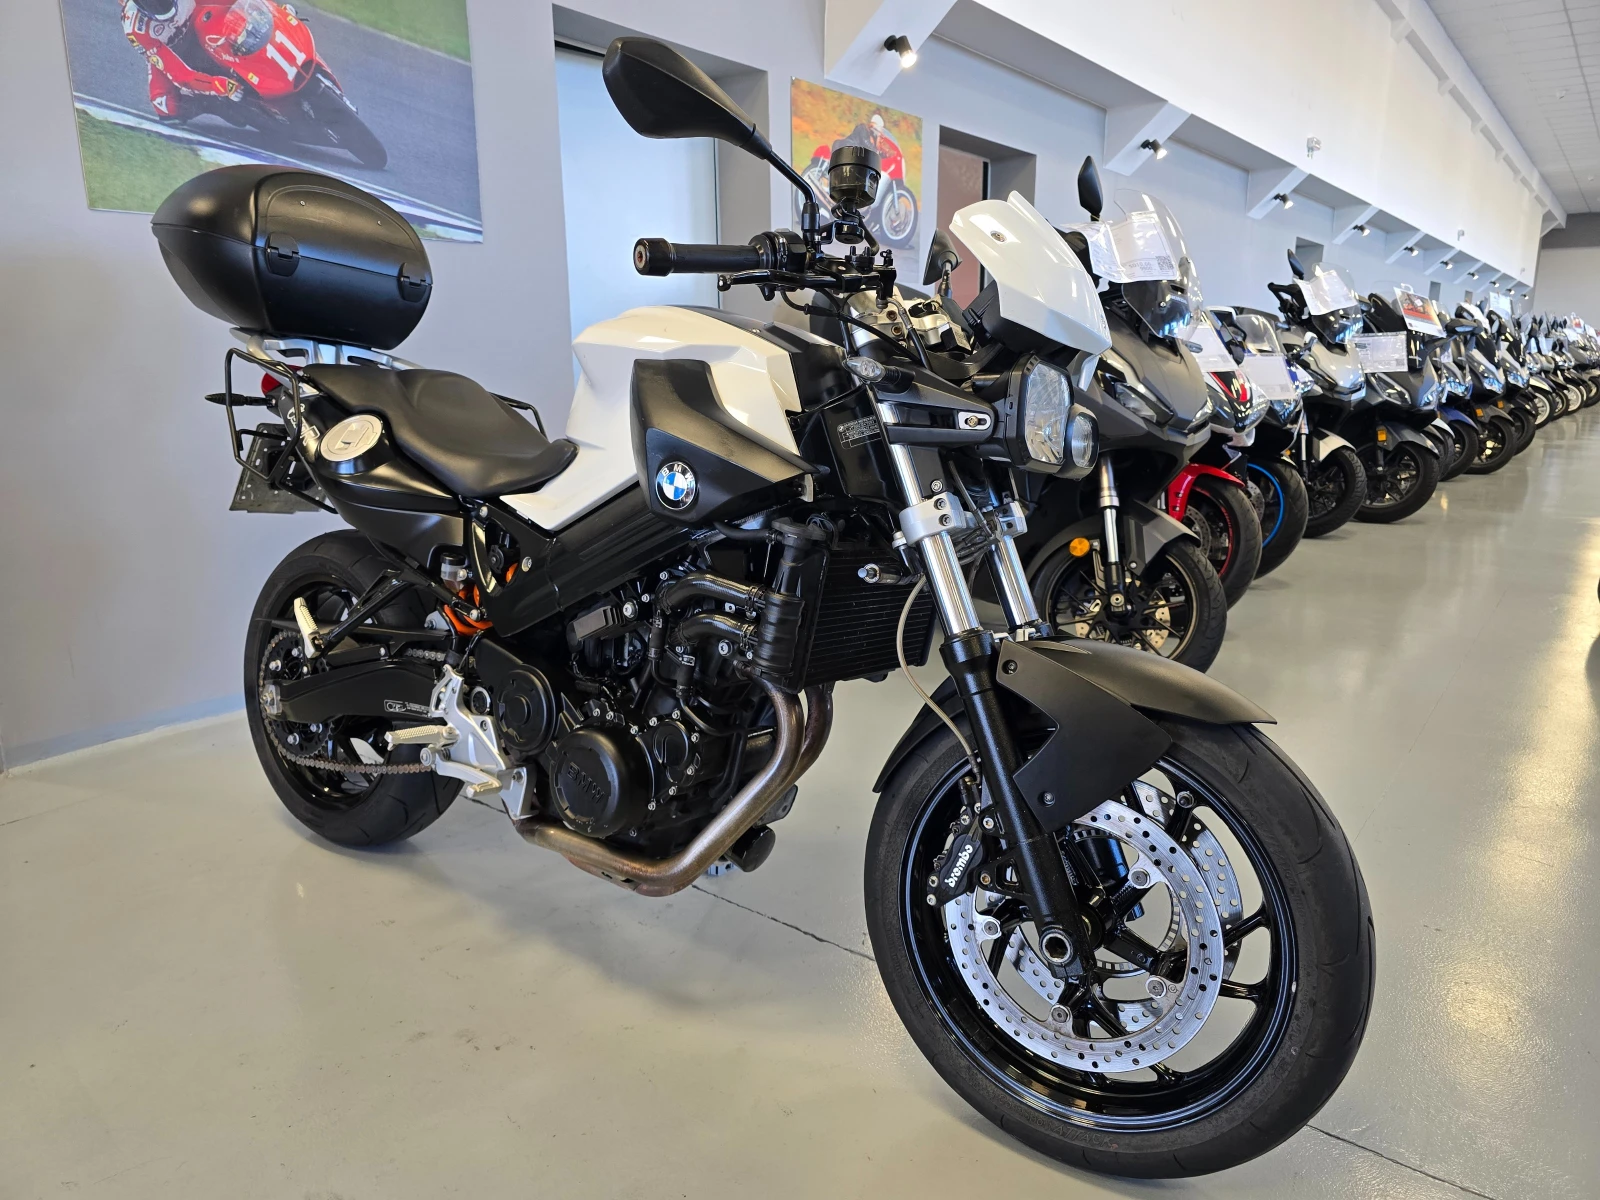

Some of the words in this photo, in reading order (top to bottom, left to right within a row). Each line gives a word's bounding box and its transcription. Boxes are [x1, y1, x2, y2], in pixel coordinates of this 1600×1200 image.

[266, 30, 306, 82] 11
[661, 463, 695, 481] BMW
[567, 761, 606, 804] BMW
[945, 844, 974, 888] brembo
